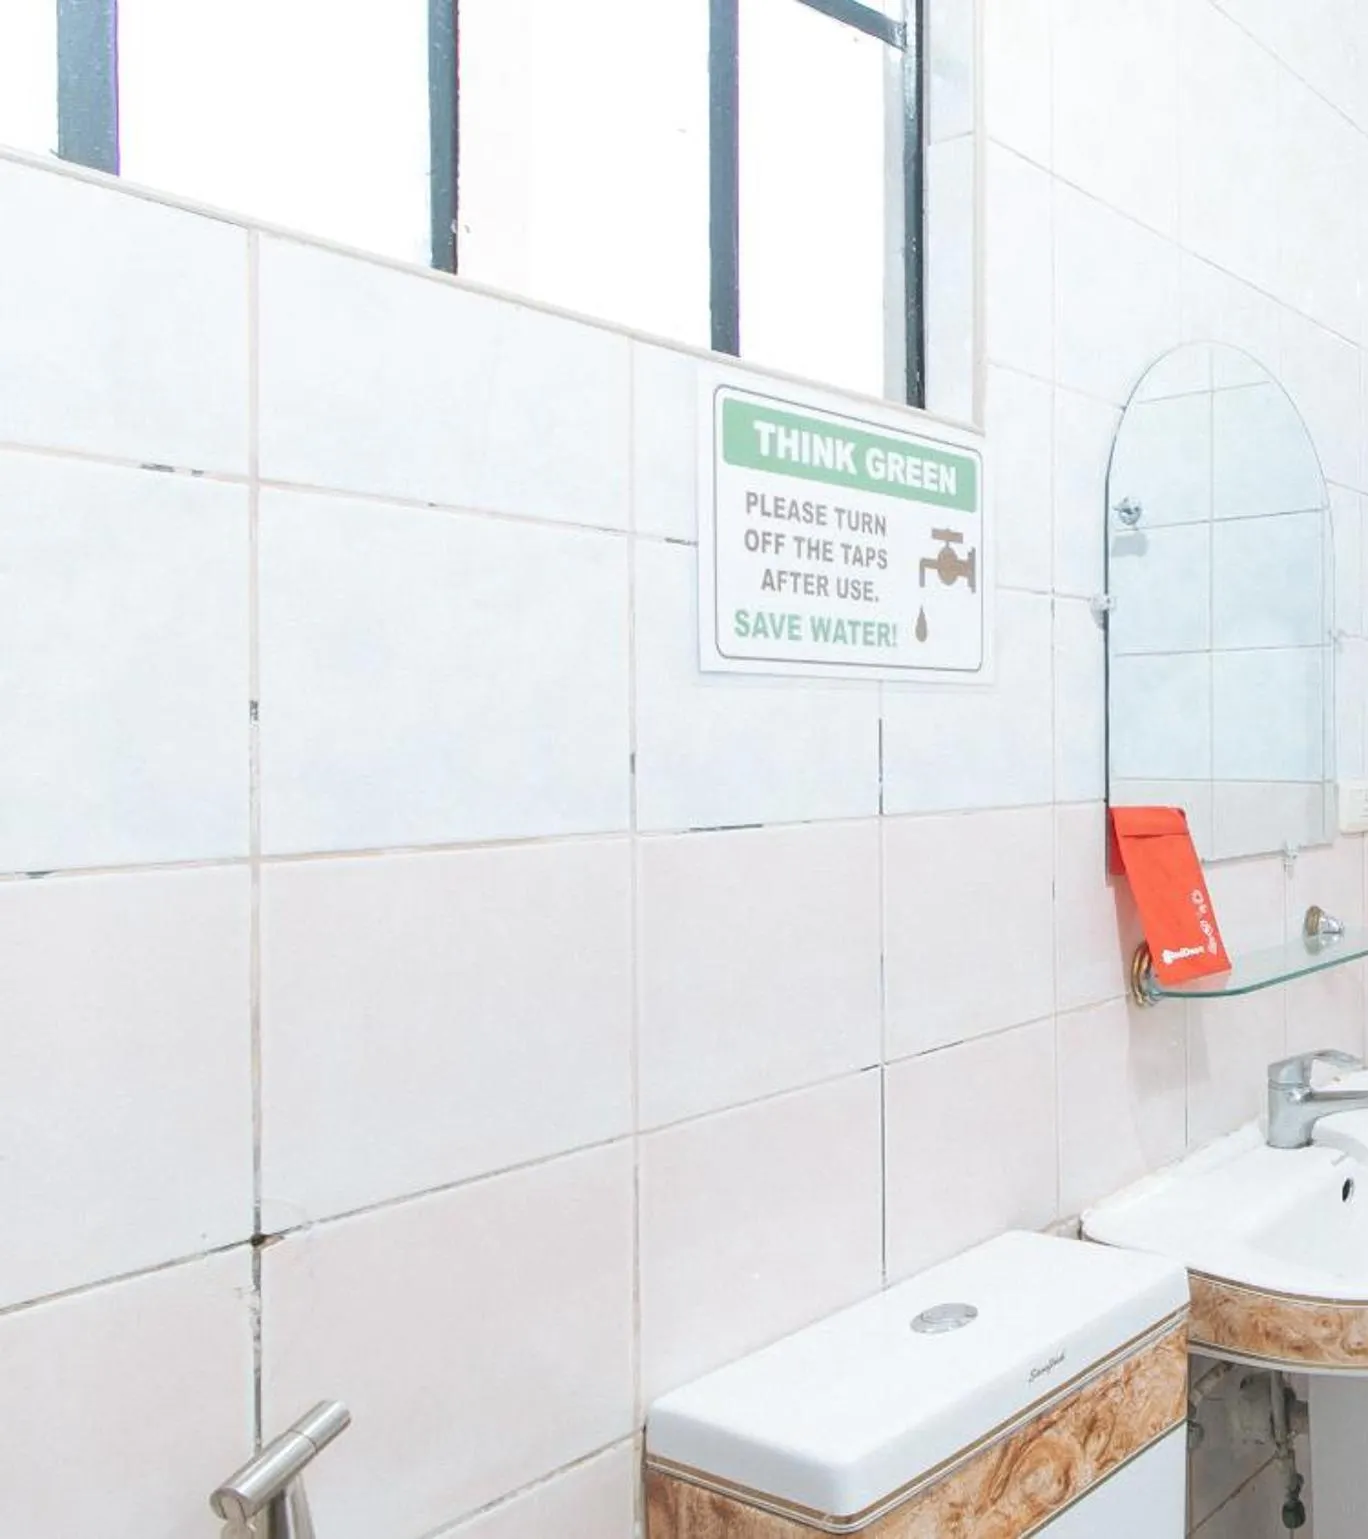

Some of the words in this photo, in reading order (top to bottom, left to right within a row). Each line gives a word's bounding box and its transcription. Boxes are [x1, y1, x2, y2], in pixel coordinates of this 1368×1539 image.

[754, 419, 856, 475] THINK
[865, 447, 956, 495] GREEN
[745, 491, 828, 525] PLEASE
[834, 506, 887, 536] TURN
[744, 529, 785, 553] OFF
[794, 536, 834, 562] THE
[841, 544, 888, 570] TAPS
[761, 568, 829, 598] AFTER
[836, 576, 879, 602] USE.
[734, 609, 801, 641] SAVE
[811, 614, 898, 647] WATER!
